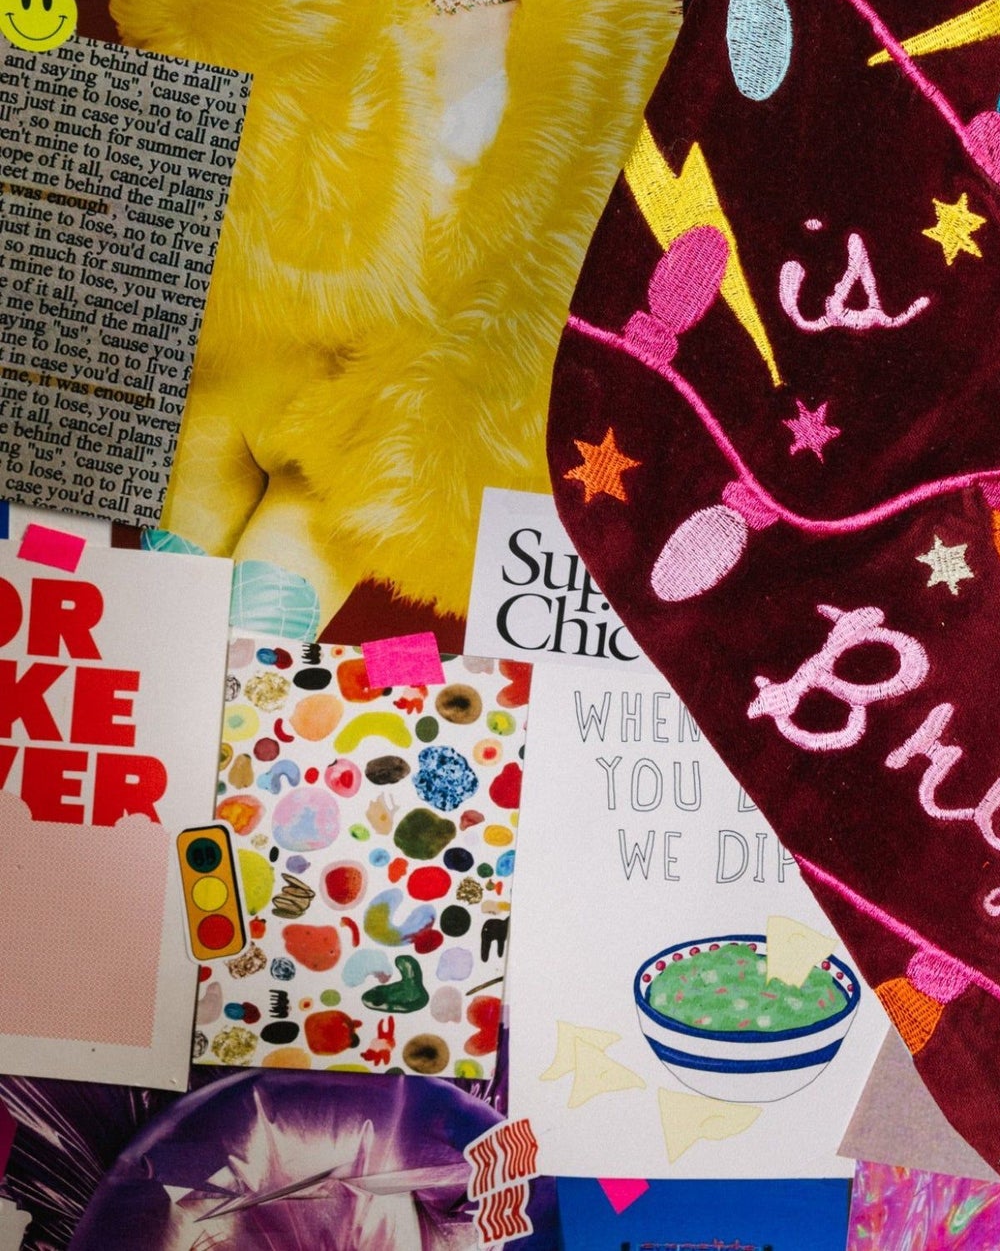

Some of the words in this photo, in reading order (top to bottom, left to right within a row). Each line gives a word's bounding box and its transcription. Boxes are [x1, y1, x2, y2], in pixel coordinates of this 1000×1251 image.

[4, 55, 37, 71] and
[40, 62, 98, 89] saying
[150, 82, 200, 106] 'cause
[202, 97, 236, 114] you
[33, 79, 78, 99] mine
[82, 87, 100, 103] to
[104, 92, 143, 115] lose,
[148, 104, 171, 118] no
[176, 107, 193, 123] to
[22, 93, 55, 113] just
[59, 101, 76, 117] in
[81, 109, 119, 125] case
[122, 116, 171, 136] you'd
[174, 128, 206, 144] call
[209, 135, 241, 152] and
[29, 116, 49, 129] so
[53, 120, 102, 141] much
[106, 129, 133, 147] for
[136, 138, 206, 162] summer
[34, 135, 78, 154] mine
[83, 143, 100, 158] to
[105, 147, 143, 171] lose,
[147, 159, 181, 178] you
[38, 154, 57, 168] of
[61, 156, 75, 172] it
[78, 161, 104, 182] all,
[110, 169, 165, 191] cancel
[167, 180, 214, 205] plans
[31, 172, 60, 187] me
[64, 175, 123, 200] behind
[127, 188, 154, 206] the
[779, 218, 930, 332] is
[1, 367, 33, 387] me,
[38, 372, 53, 387] it
[56, 379, 89, 395] was
[93, 386, 155, 411] enough
[5, 478, 42, 495] case
[45, 486, 94, 505] you'd
[98, 497, 129, 513] call
[133, 504, 163, 520] and
[496, 593, 640, 662] Chic
[0, 745, 168, 827] ER
[596, 755, 702, 812] YOU
[618, 828, 682, 882] WE
[469, 1135, 498, 1197] TRY
[496, 1119, 538, 1183] YOUR
[477, 1184, 528, 1243] LUCK
